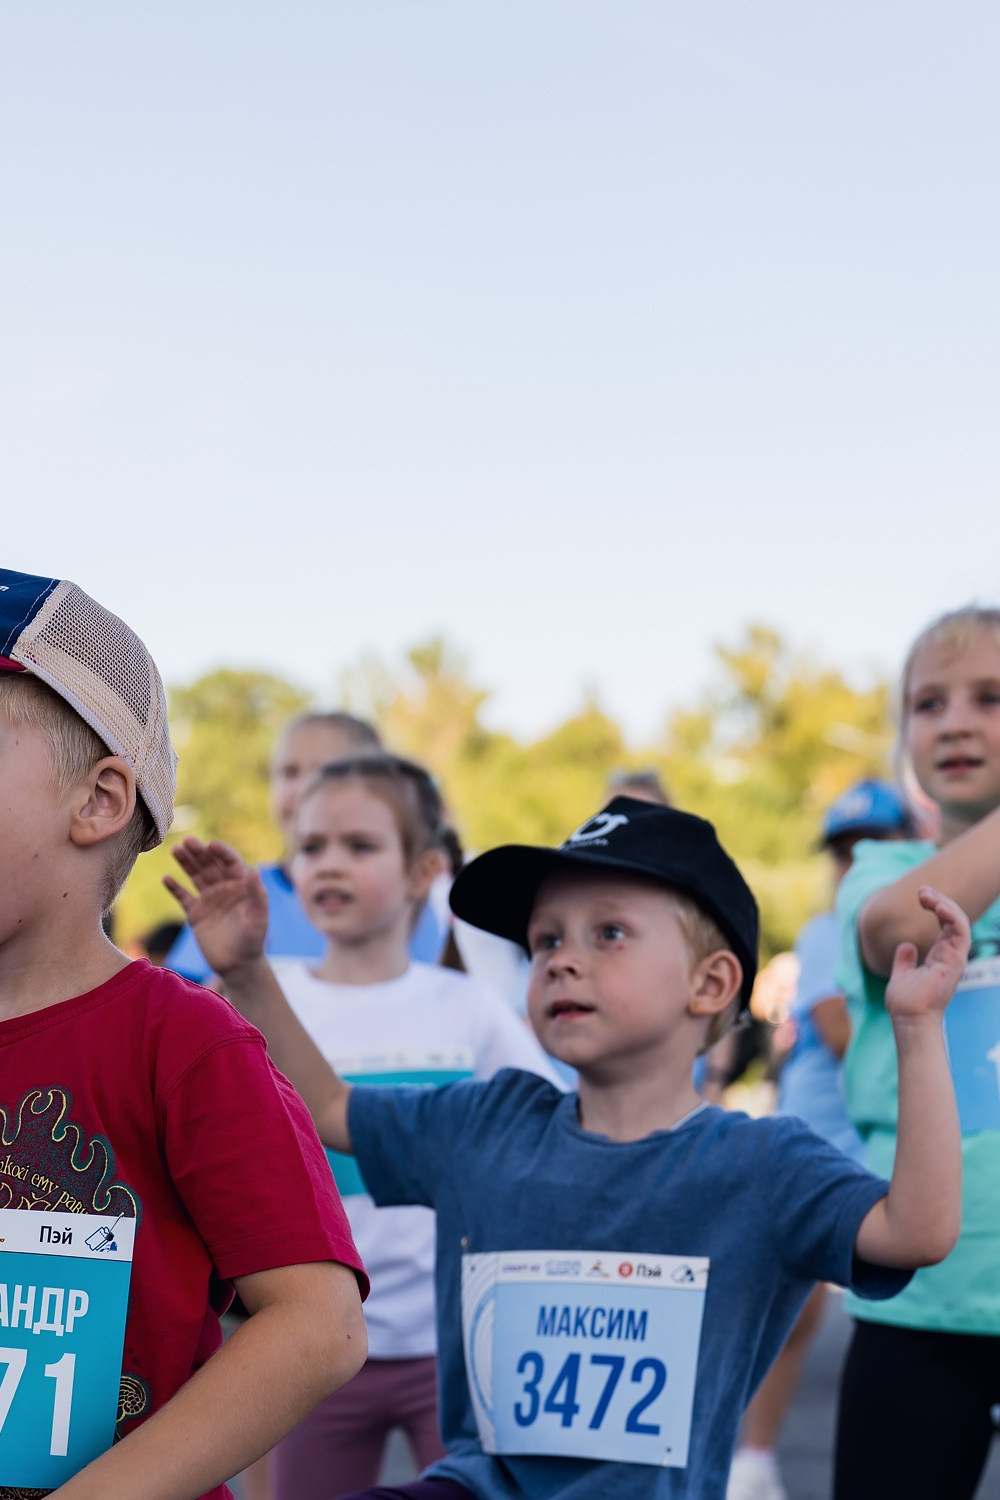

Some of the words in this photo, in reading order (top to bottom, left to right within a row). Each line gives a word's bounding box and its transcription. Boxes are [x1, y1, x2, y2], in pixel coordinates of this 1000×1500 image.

[31, 1173, 60, 1200] ему
[40, 1225, 73, 1245] Пэй
[536, 1305, 649, 1342] МАКСИМ
[514, 1351, 668, 1437] 3472
